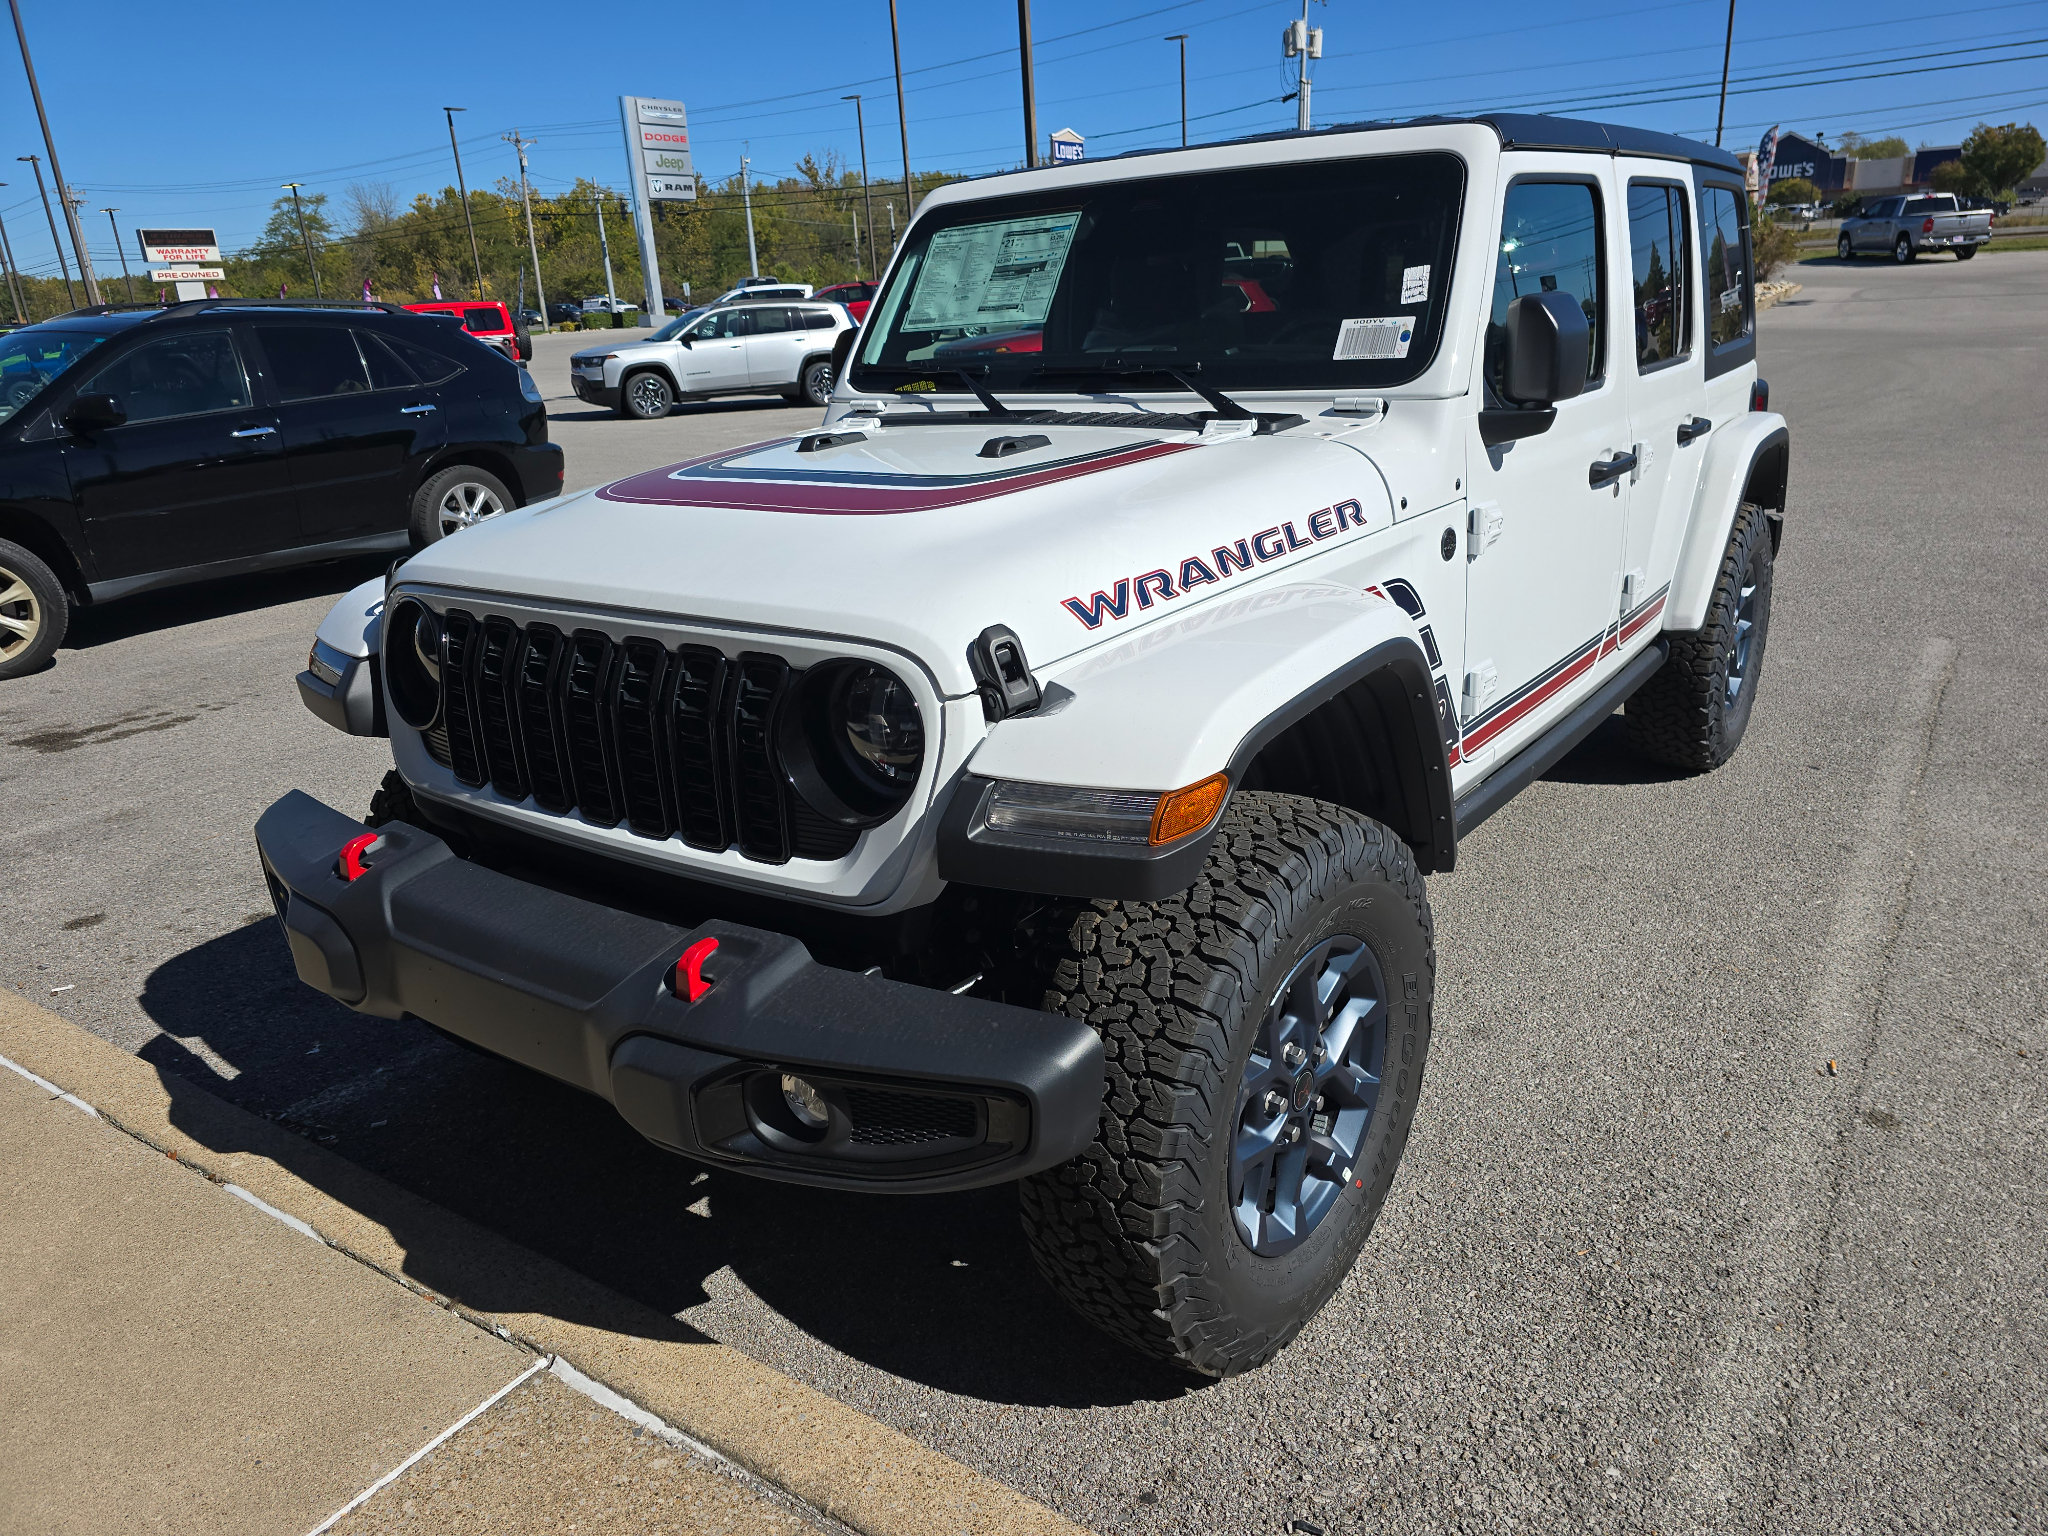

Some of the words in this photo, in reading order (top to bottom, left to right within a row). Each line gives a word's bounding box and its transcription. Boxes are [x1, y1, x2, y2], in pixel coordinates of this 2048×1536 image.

[641, 104, 682, 113] CHRYSLER
[644, 132, 687, 143] DODGE
[1054, 142, 1083, 160] LOWE'S
[655, 153, 684, 171] Jeep
[1769, 161, 1814, 179] OWE'S
[665, 183, 693, 192] RAM
[157, 271, 219, 279] PRE-OWNED
[1060, 498, 1367, 630] WRANGLER
